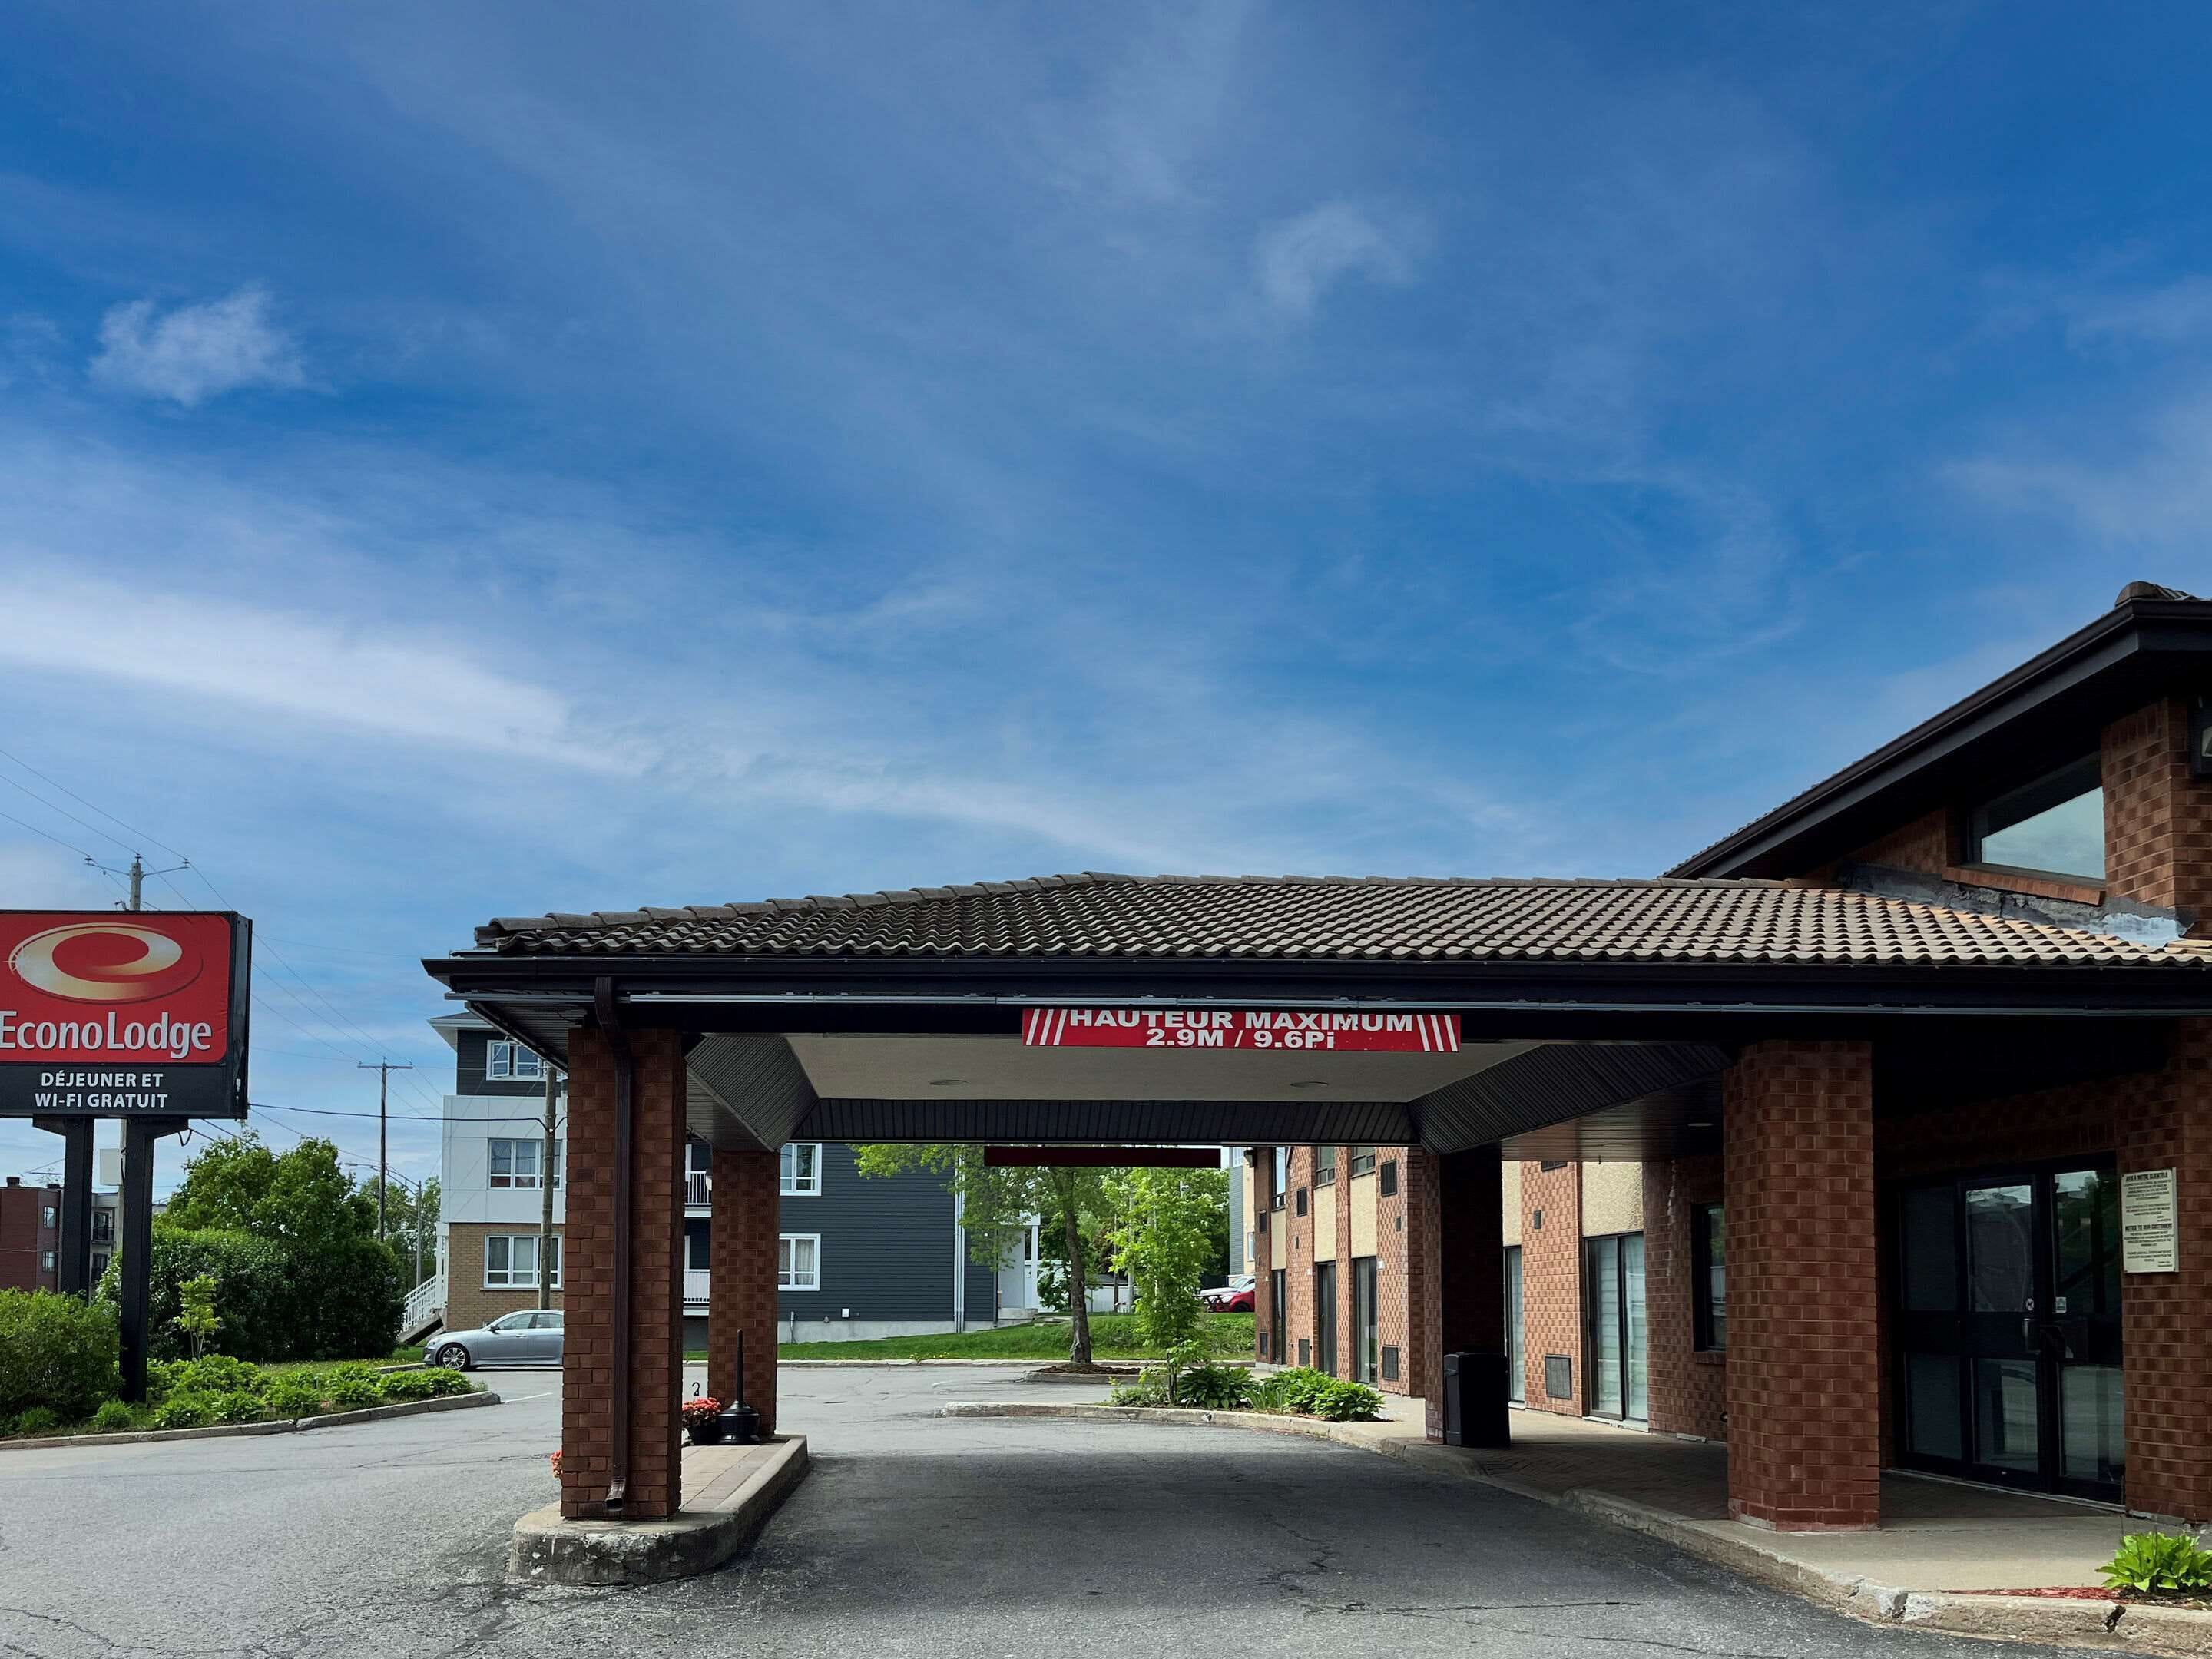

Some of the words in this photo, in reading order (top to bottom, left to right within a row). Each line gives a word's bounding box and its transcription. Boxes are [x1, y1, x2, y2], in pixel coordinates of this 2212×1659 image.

[1069, 1009, 1233, 1029] HAUTEUR
[1245, 1012, 1414, 1032] MAXIMUM
[0, 1010, 212, 1059] EconoLodge
[1146, 1029, 1224, 1047] 2.9M
[1253, 1031, 1335, 1049] 9.6Pi
[41, 1069, 137, 1088] DÉJEUNER
[142, 1073, 164, 1088] ET
[35, 1093, 82, 1108] WI-FI
[88, 1093, 168, 1108] GRATUIT
